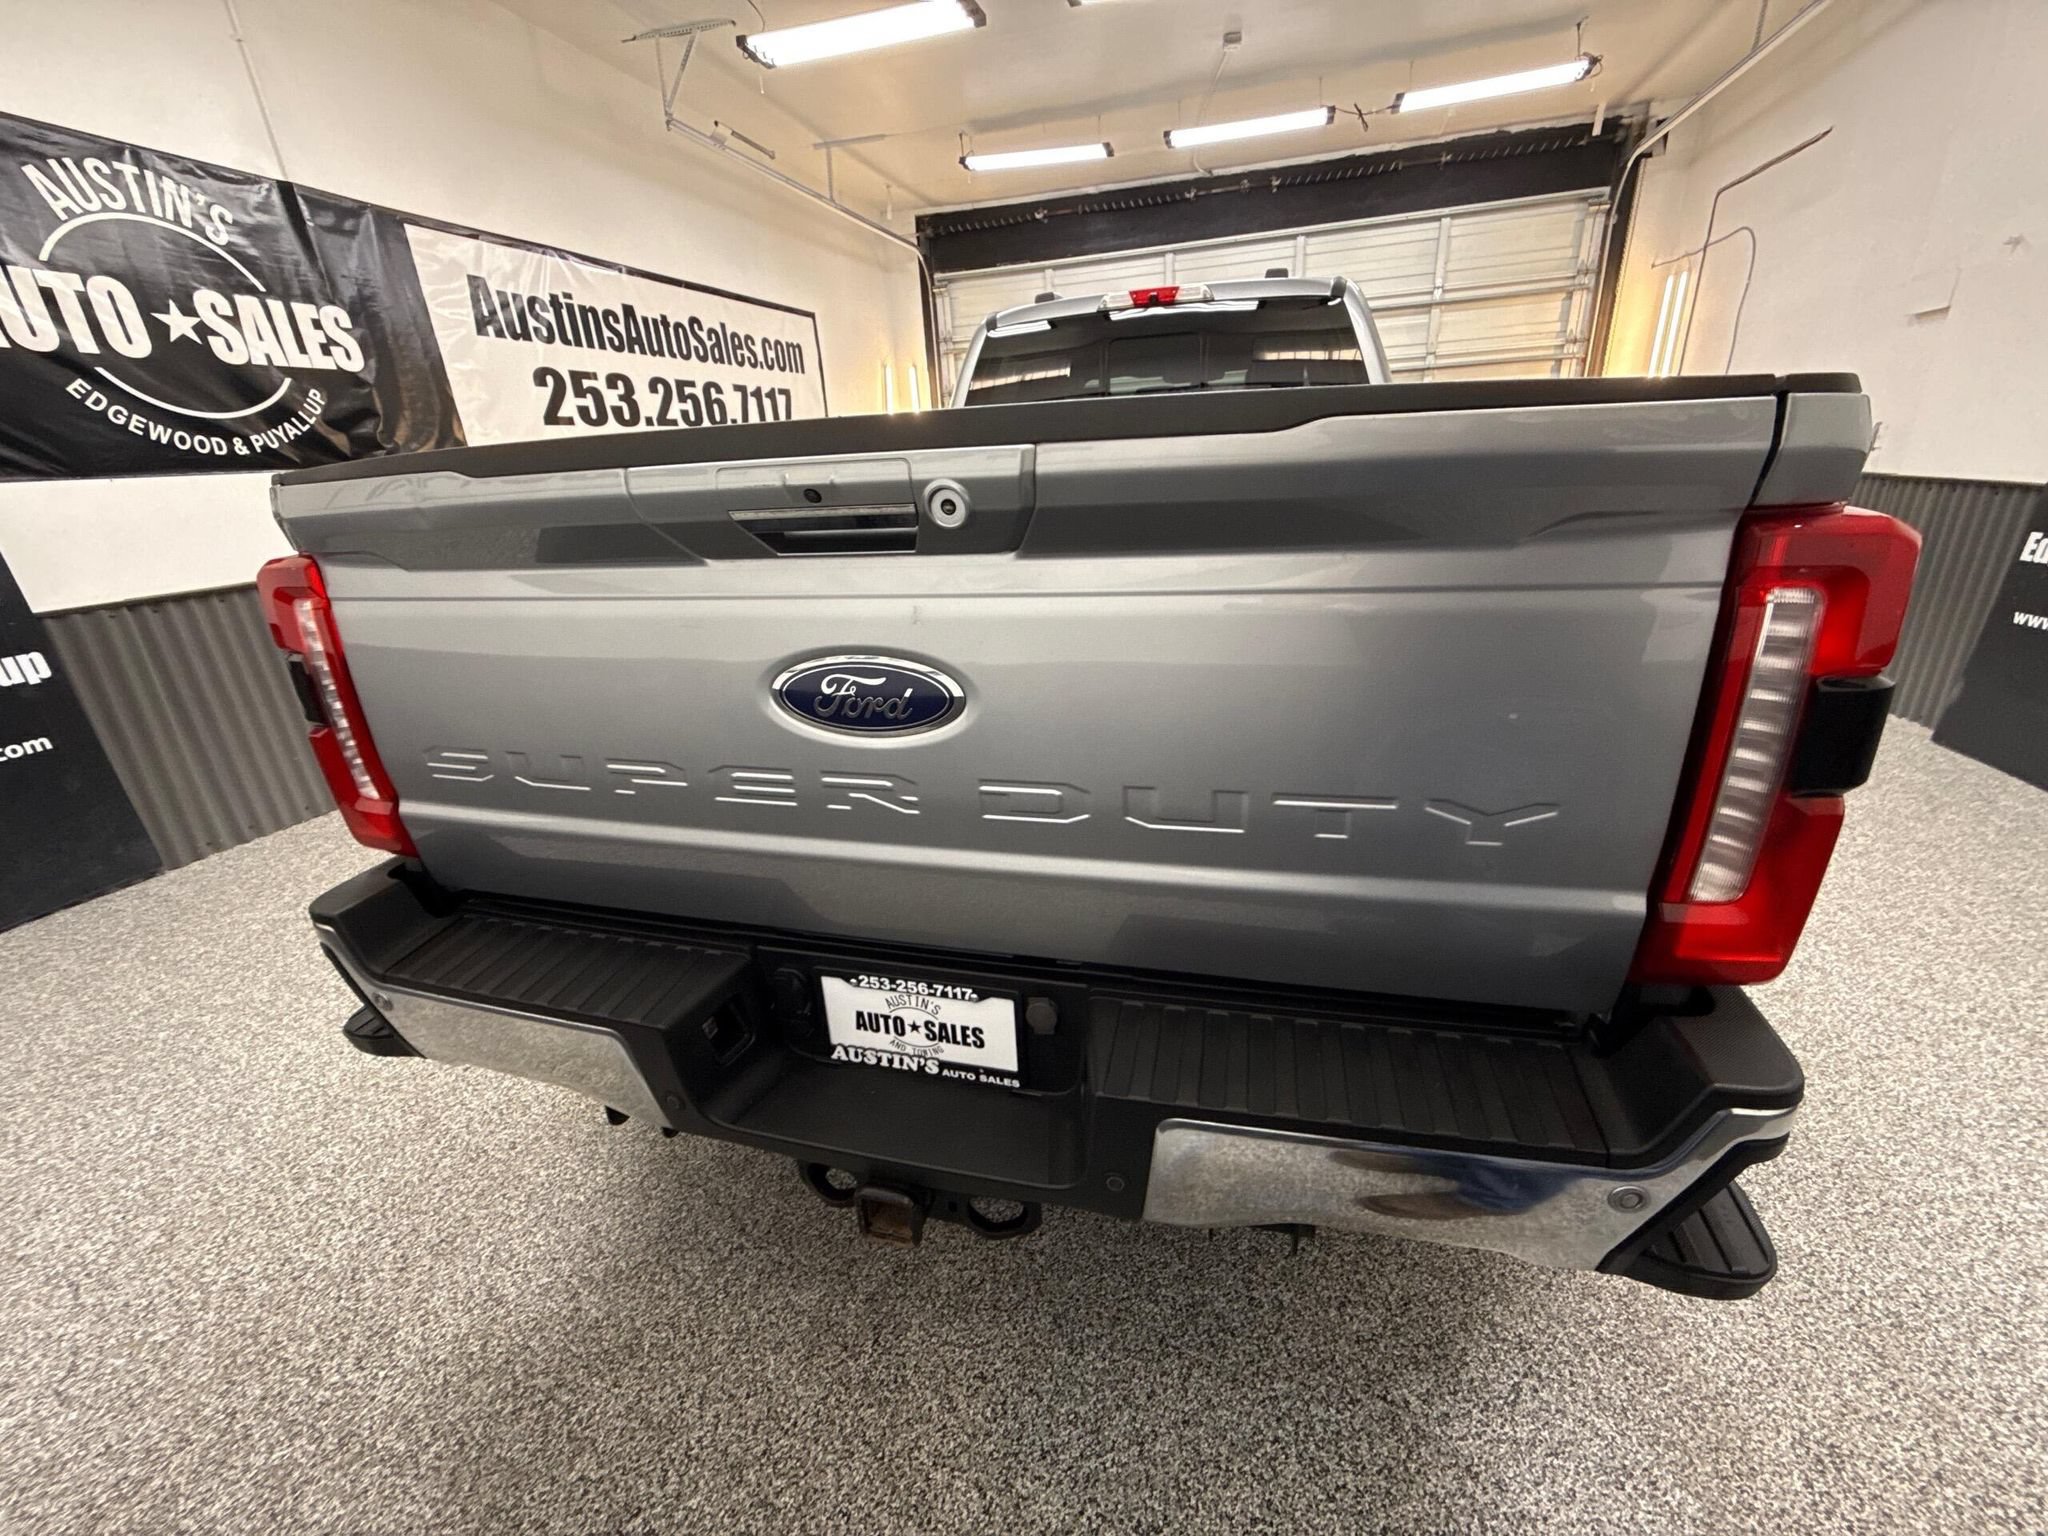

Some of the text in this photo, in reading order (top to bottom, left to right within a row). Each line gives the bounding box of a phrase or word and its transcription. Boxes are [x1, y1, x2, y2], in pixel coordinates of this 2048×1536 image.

[22, 156, 234, 246] AUSTIN'S
[192, 289, 366, 374] SALES
[466, 274, 806, 375] AustinsAutoSales.com
[65, 378, 327, 456] EDGEWOOD & PUYALLUP
[532, 366, 793, 428] 253.256.7117
[814, 672, 915, 720] Ford
[423, 746, 1561, 847] SUPER DUTY
[855, 1010, 985, 1049] AUTO SALES
[885, 993, 942, 1017] AUSTIN'S
[831, 1044, 1021, 1089] AUSTIN'S AUTO SALES
[889, 1038, 907, 1053] AND
